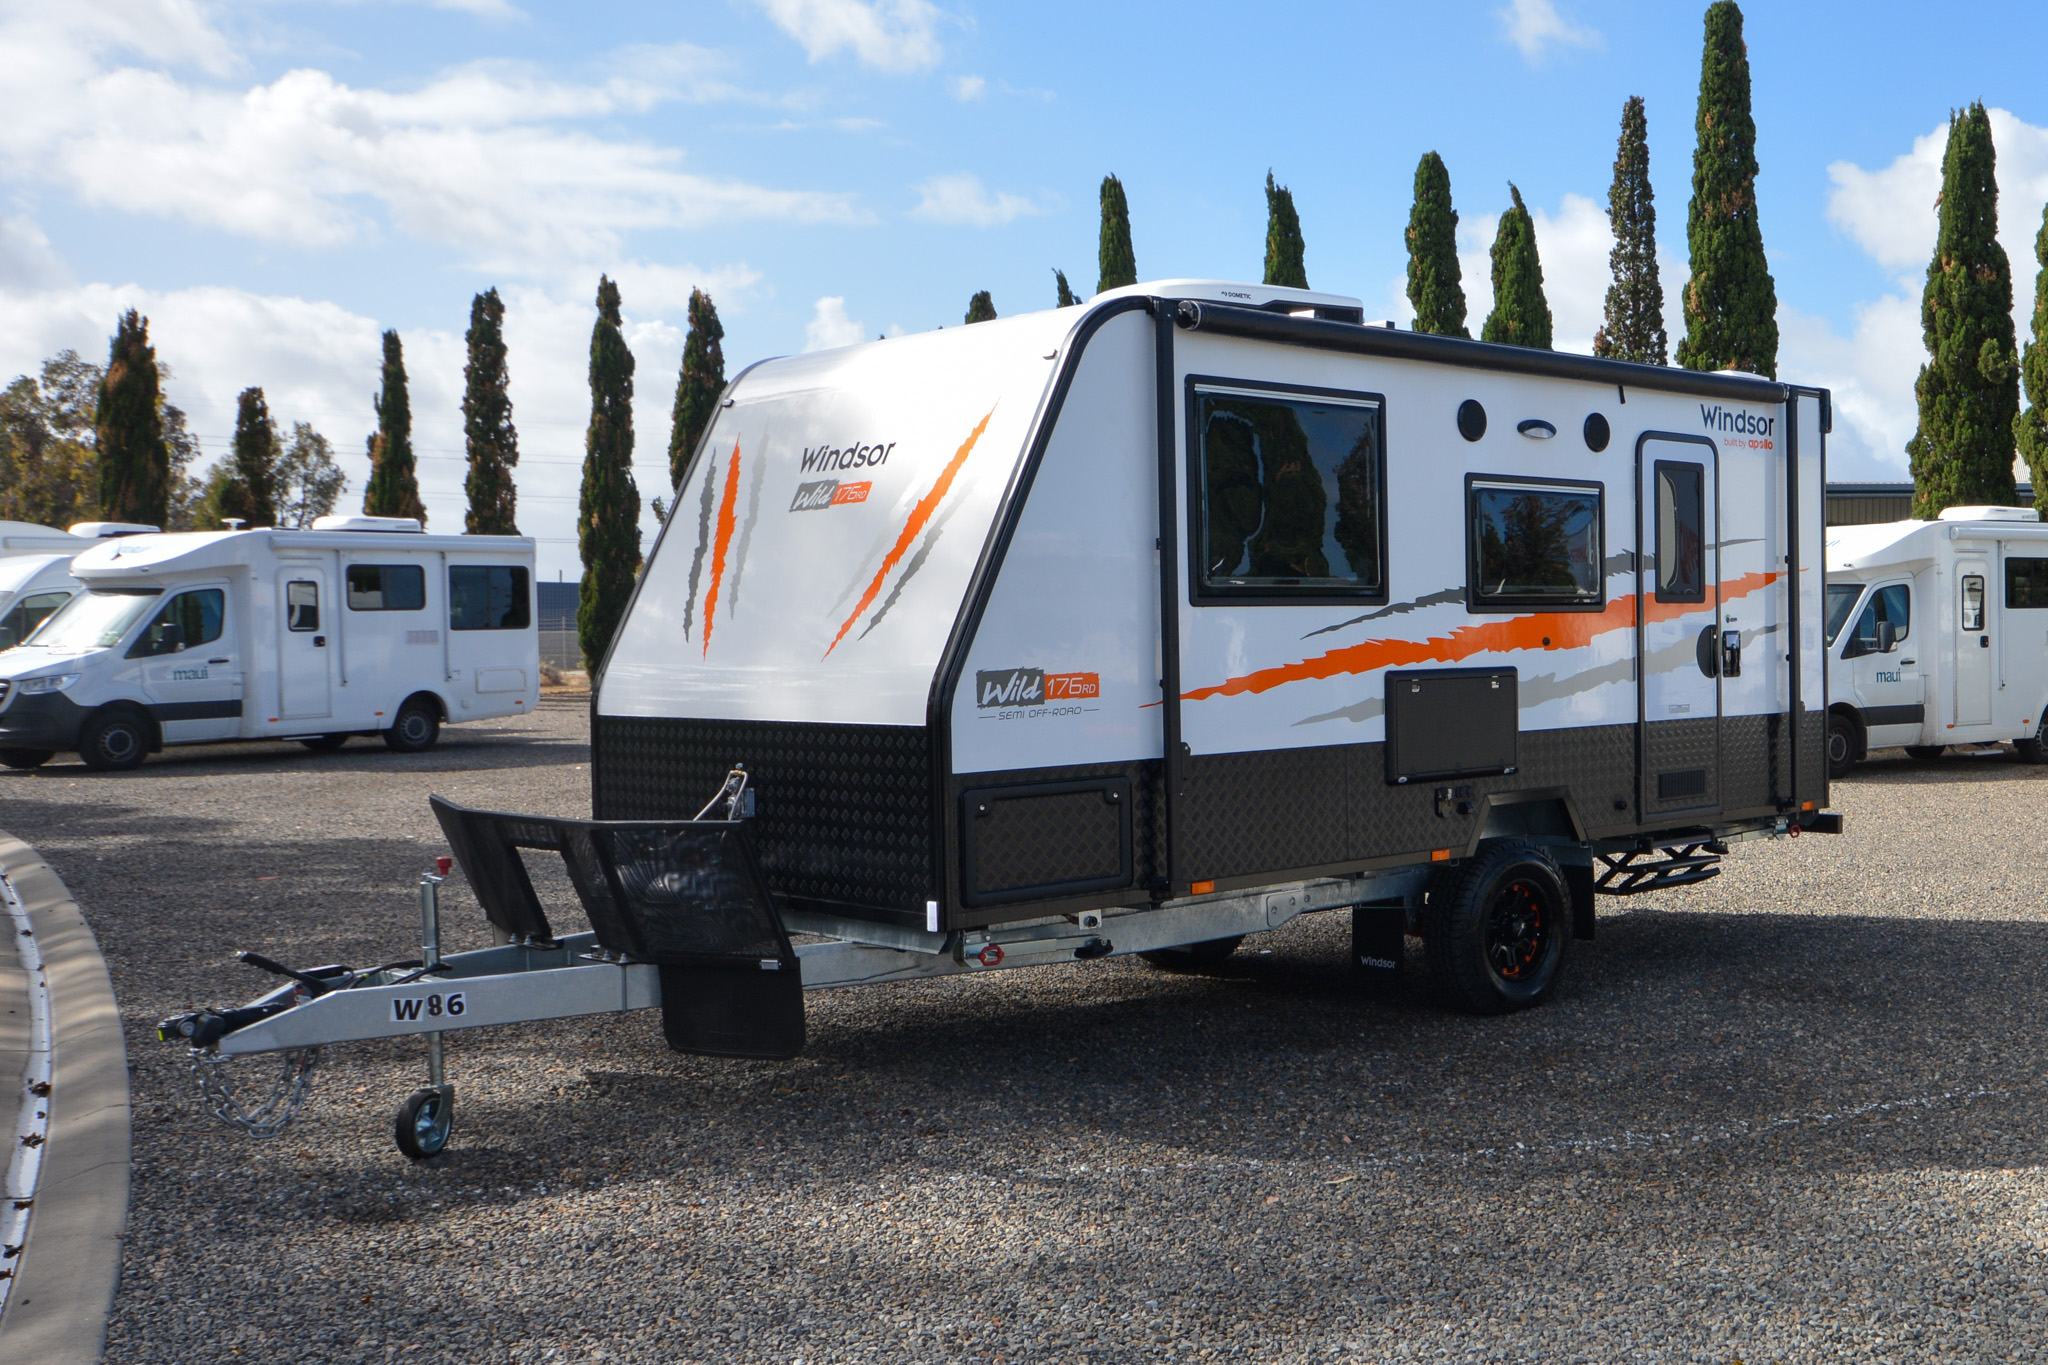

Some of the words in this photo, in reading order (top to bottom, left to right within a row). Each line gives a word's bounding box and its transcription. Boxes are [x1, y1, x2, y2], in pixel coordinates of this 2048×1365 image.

[1228, 291, 1252, 300] DOMETIC
[1700, 403, 1774, 436] Windsor
[1724, 437, 1738, 447] built
[1739, 439, 1747, 449] by
[1748, 438, 1773, 450] apollo
[800, 441, 896, 474] Windsor
[793, 482, 836, 510] Wild
[834, 485, 868, 502] 176RD
[173, 665, 208, 681] maui
[1876, 667, 1901, 683] maui
[982, 671, 1042, 705] Wild
[1047, 677, 1096, 696] 176RD
[998, 710, 1025, 721] SEMI
[1028, 707, 1082, 719] OFF-ROAD
[1360, 955, 1396, 969] Windsor
